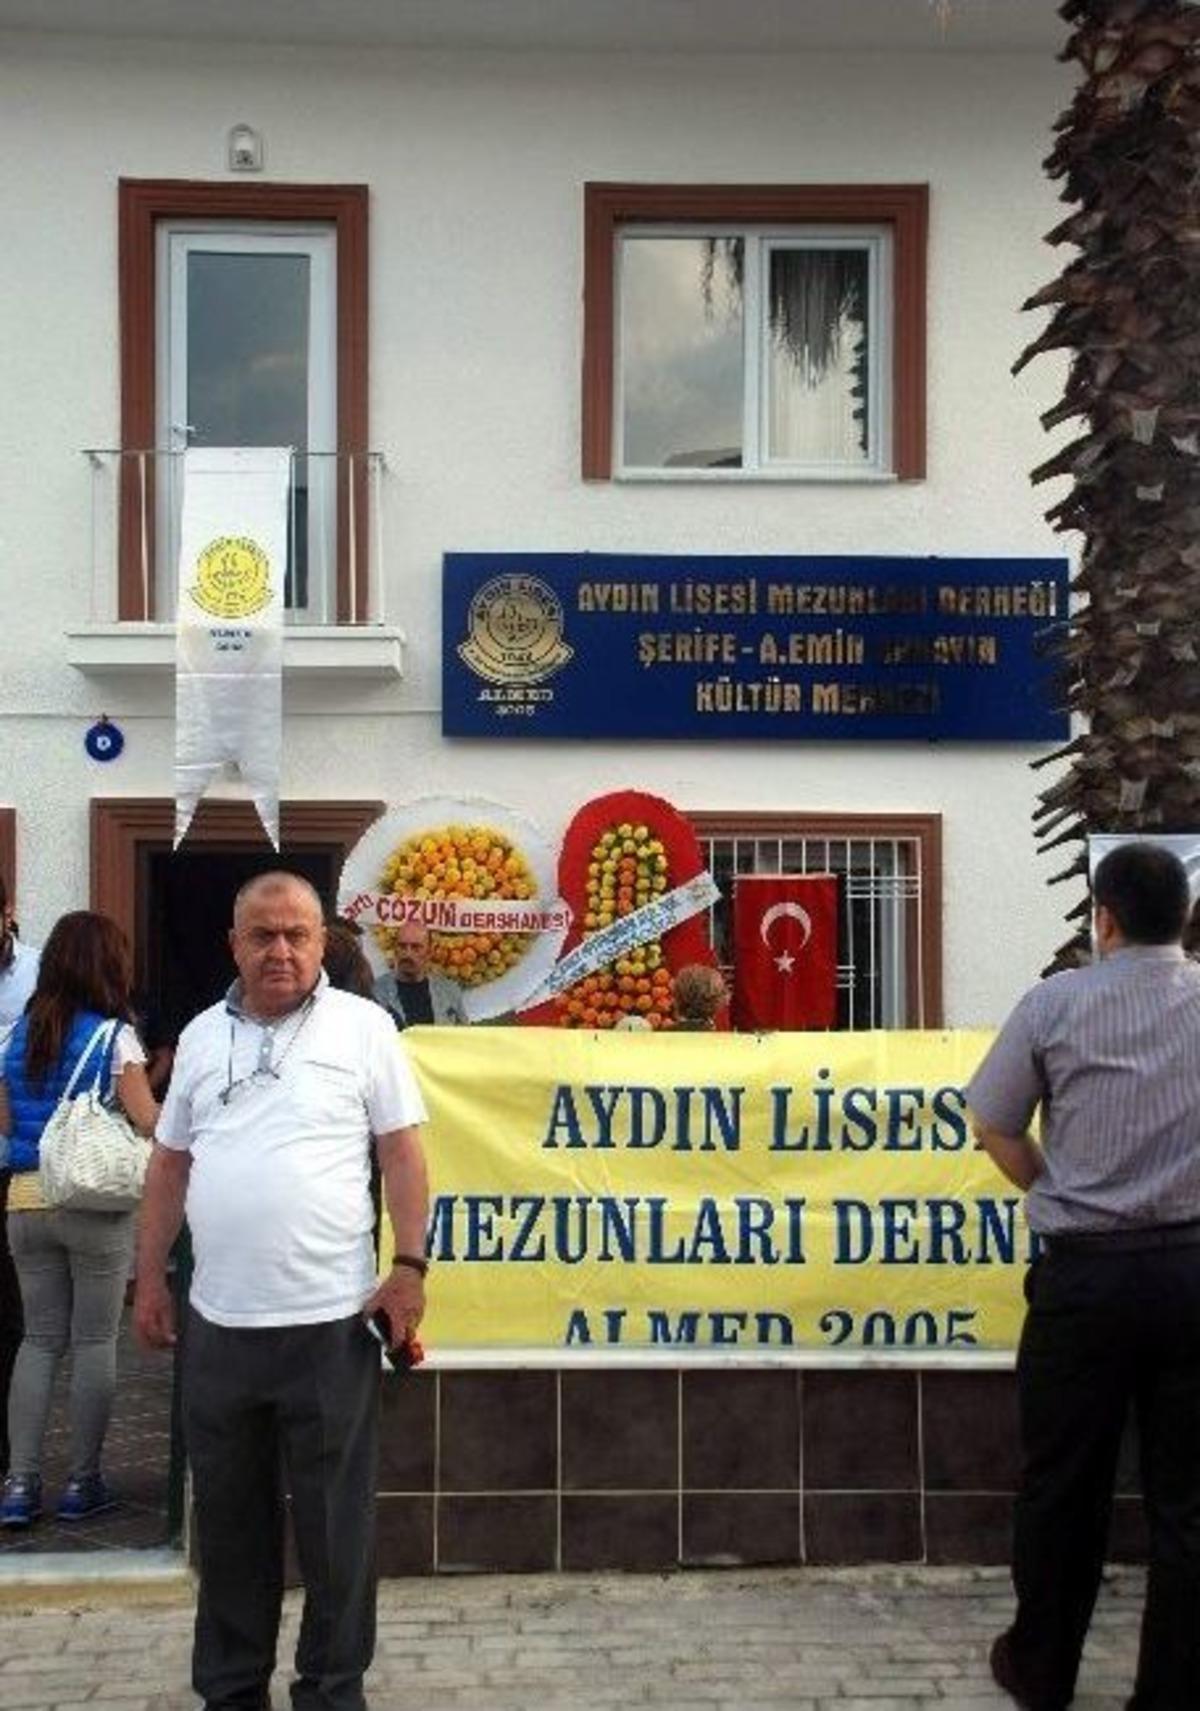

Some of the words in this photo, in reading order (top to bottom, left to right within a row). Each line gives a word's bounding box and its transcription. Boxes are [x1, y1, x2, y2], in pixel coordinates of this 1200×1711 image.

[578, 582, 660, 613] AYDIN
[670, 577, 757, 615] LİSESİ
[639, 627, 737, 668] ŞERİFE
[696, 676, 801, 713] KÜLTÜR
[542, 1084, 746, 1151] AYDIN
[768, 1067, 983, 1152] LİSES
[832, 1197, 1043, 1266] DERN
